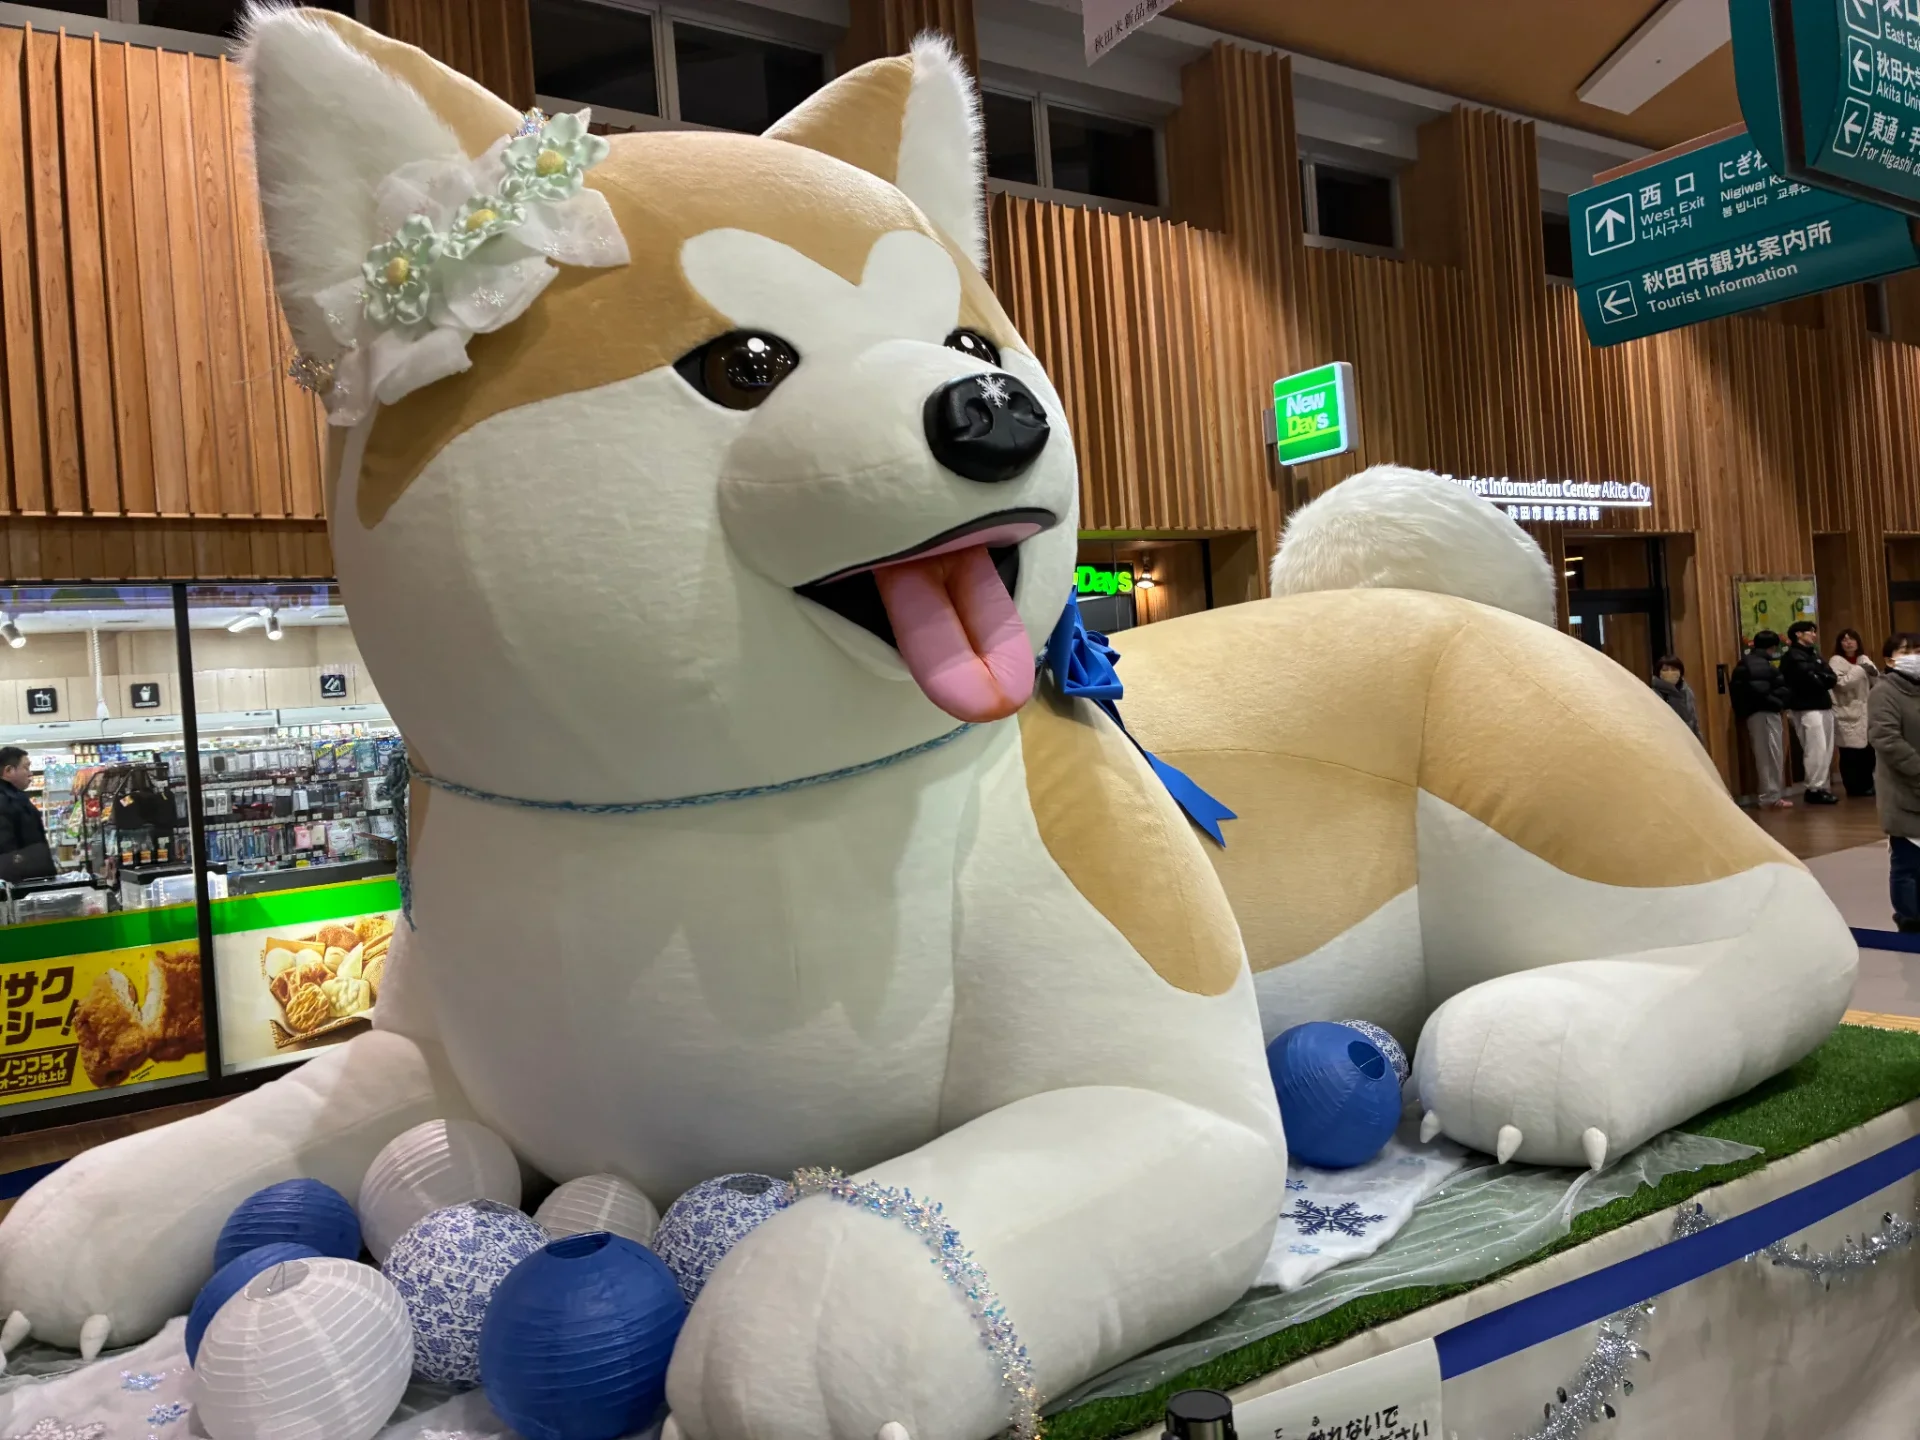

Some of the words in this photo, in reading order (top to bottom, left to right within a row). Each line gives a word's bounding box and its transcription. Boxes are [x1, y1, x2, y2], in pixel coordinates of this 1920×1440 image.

[1885, 21, 1905, 46] East
[1876, 80, 1901, 103] Akita
[1860, 141, 1879, 160] For
[1879, 147, 1914, 173] Higashi
[1639, 172, 1695, 210] 西口
[1640, 206, 1675, 226] West
[1679, 196, 1705, 215] Exit
[1720, 178, 1766, 202] Nigiwai
[1642, 220, 1832, 295] 秋田市観光案内所
[1647, 291, 1702, 313] Tourist
[1705, 263, 1798, 298] Information
[1286, 392, 1326, 417] New
[1287, 413, 1330, 437] Days
[1489, 477, 1561, 497] Information
[1562, 480, 1600, 498] Center
[1602, 481, 1628, 499] Akita
[1629, 481, 1650, 502] City
[1077, 566, 1133, 595] Days
[0, 966, 74, 1009] サク
[0, 999, 79, 1046] シー!
